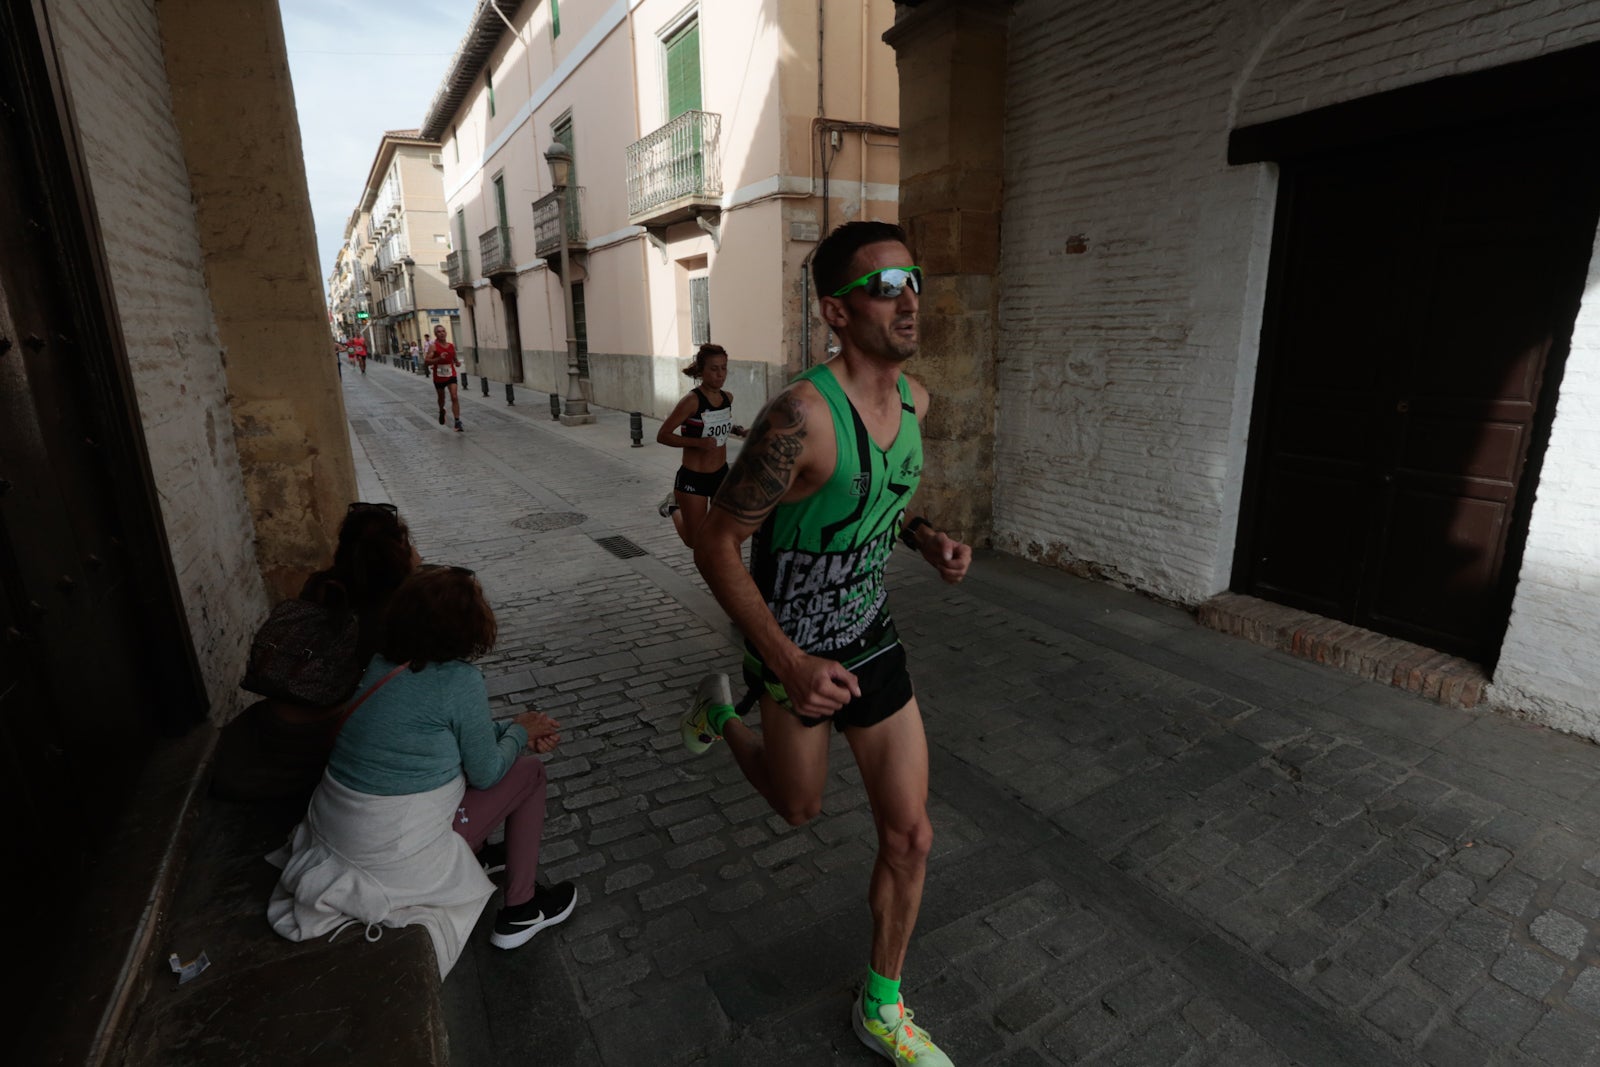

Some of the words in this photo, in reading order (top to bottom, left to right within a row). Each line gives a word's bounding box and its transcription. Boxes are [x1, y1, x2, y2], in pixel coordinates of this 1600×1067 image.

[707, 422, 732, 438] 3003
[772, 550, 857, 599] TEAM
[806, 590, 837, 615] DE
